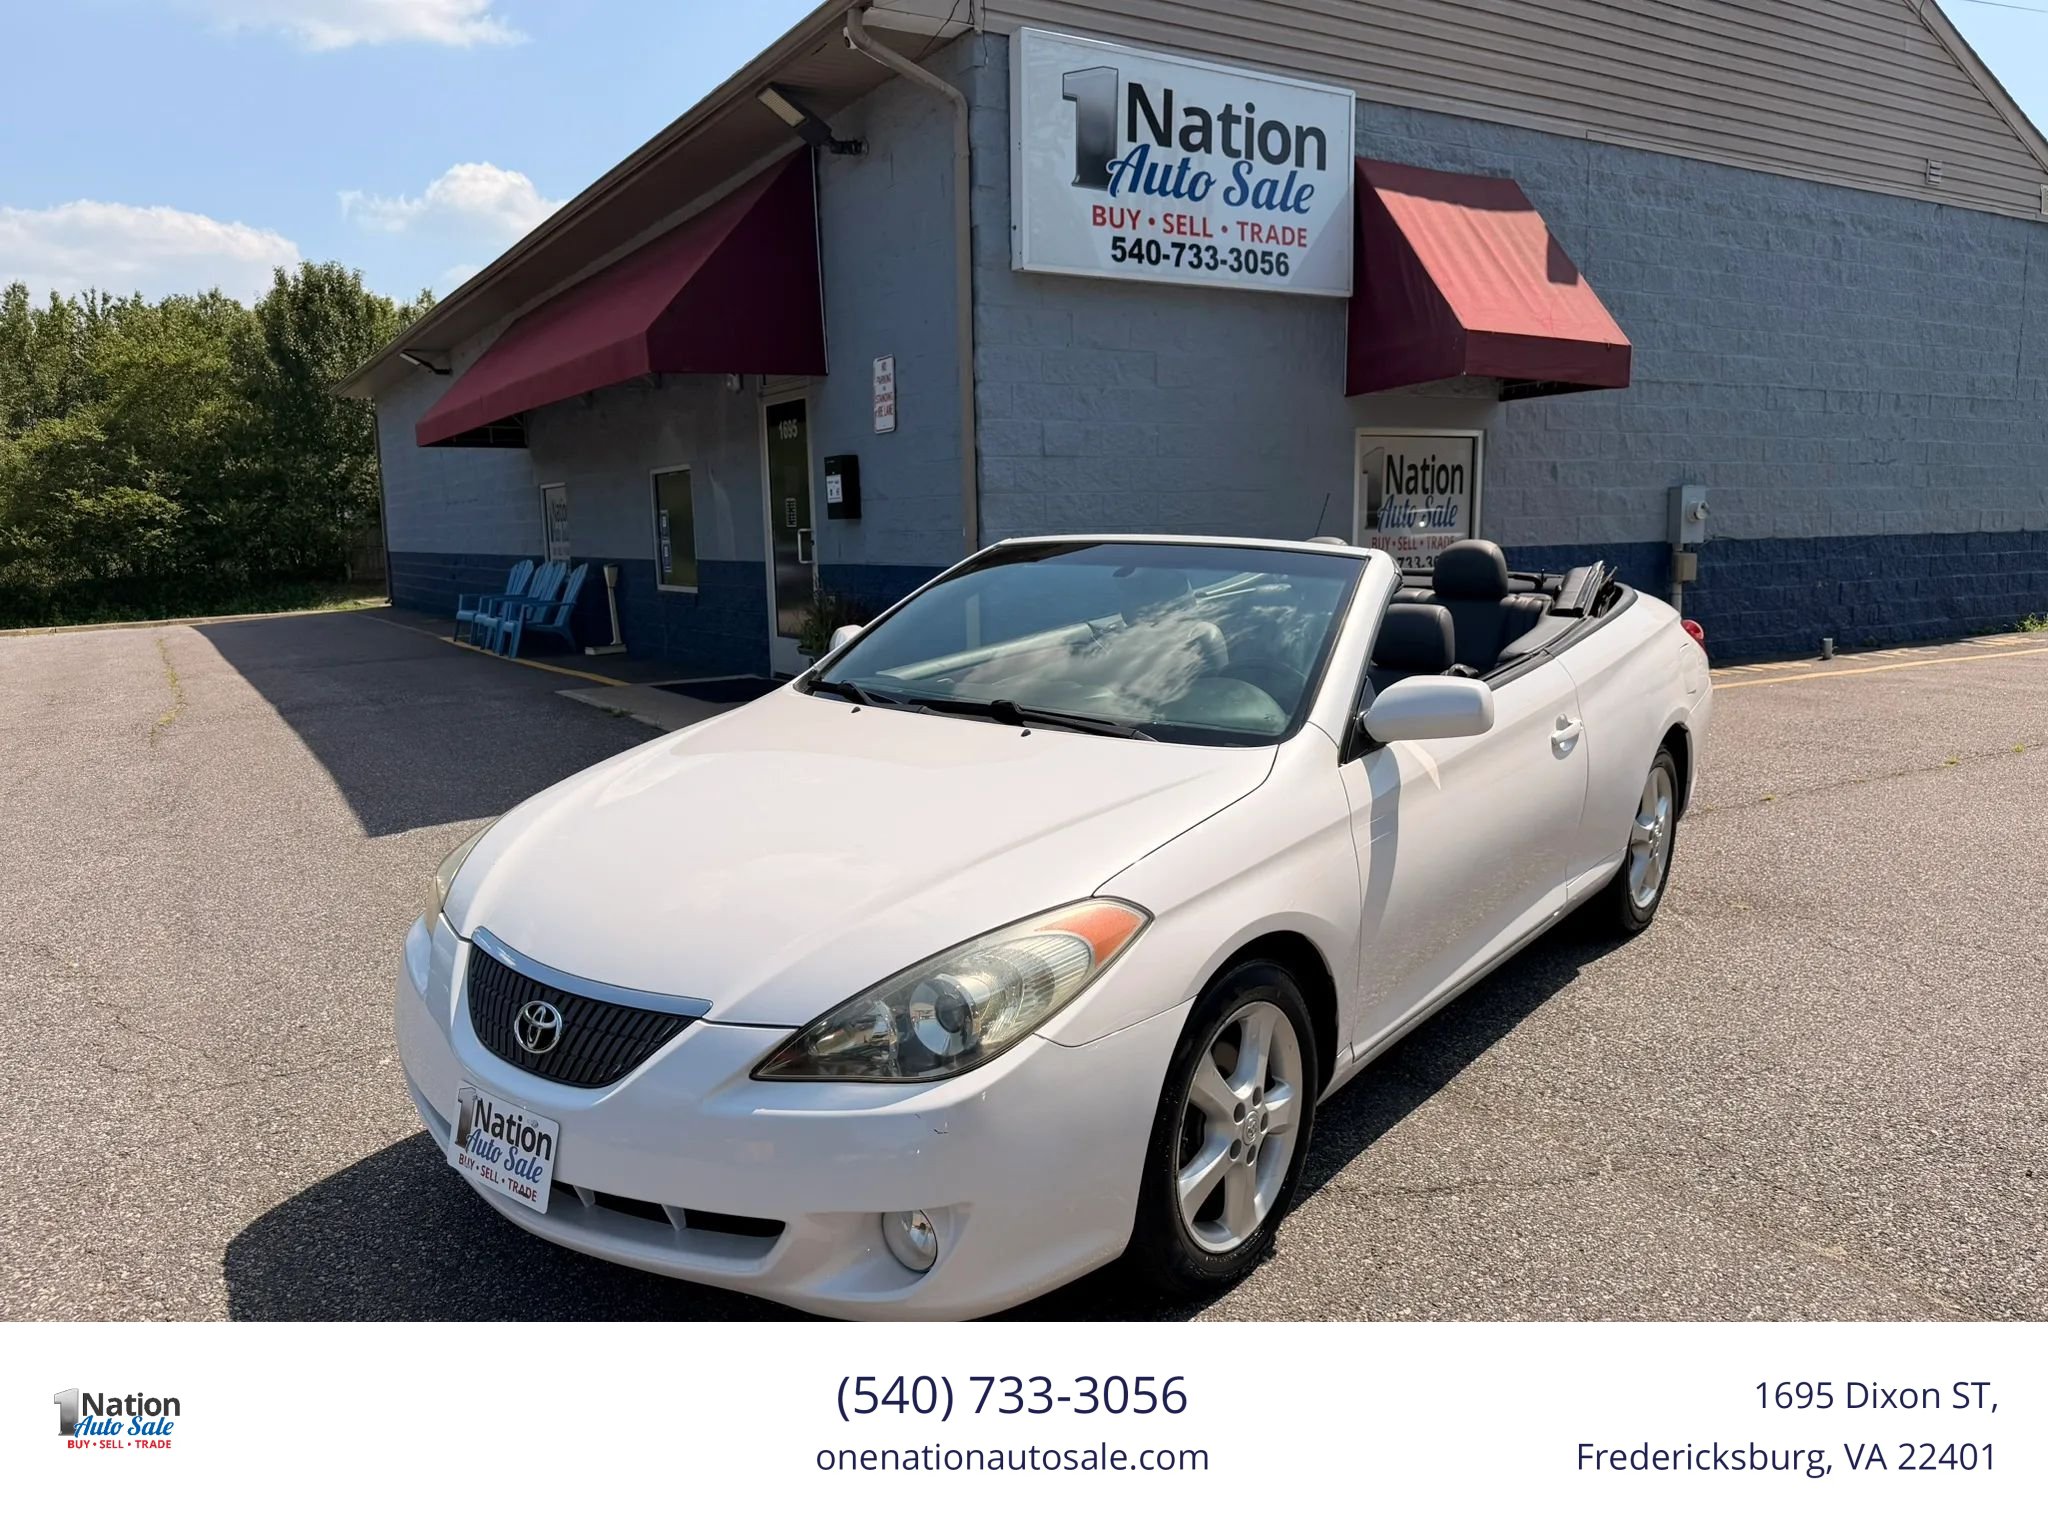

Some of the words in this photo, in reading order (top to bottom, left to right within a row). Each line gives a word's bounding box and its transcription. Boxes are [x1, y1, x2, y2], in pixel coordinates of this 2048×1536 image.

[1127, 81, 1327, 171] Nation
[1106, 143, 1216, 202] Auto
[1223, 160, 1315, 215] Sale
[1092, 204, 1141, 231] BUY
[1163, 212, 1213, 238] SELL
[1236, 221, 1307, 248] TRADE
[1111, 236, 1289, 277] 540-733-3056
[1386, 454, 1464, 495] Nation
[1377, 494, 1416, 533] Auto
[1420, 495, 1458, 529] Sale
[1371, 536, 1391, 551] BUY
[1397, 536, 1417, 551] SELL
[475, 1097, 552, 1161] Nation
[459, 1153, 475, 1171] BUY
[480, 1165, 499, 1184] SELL
[508, 1178, 537, 1203] TRADE
[466, 1128, 502, 1164] Auto
[503, 1146, 543, 1184] Sale
